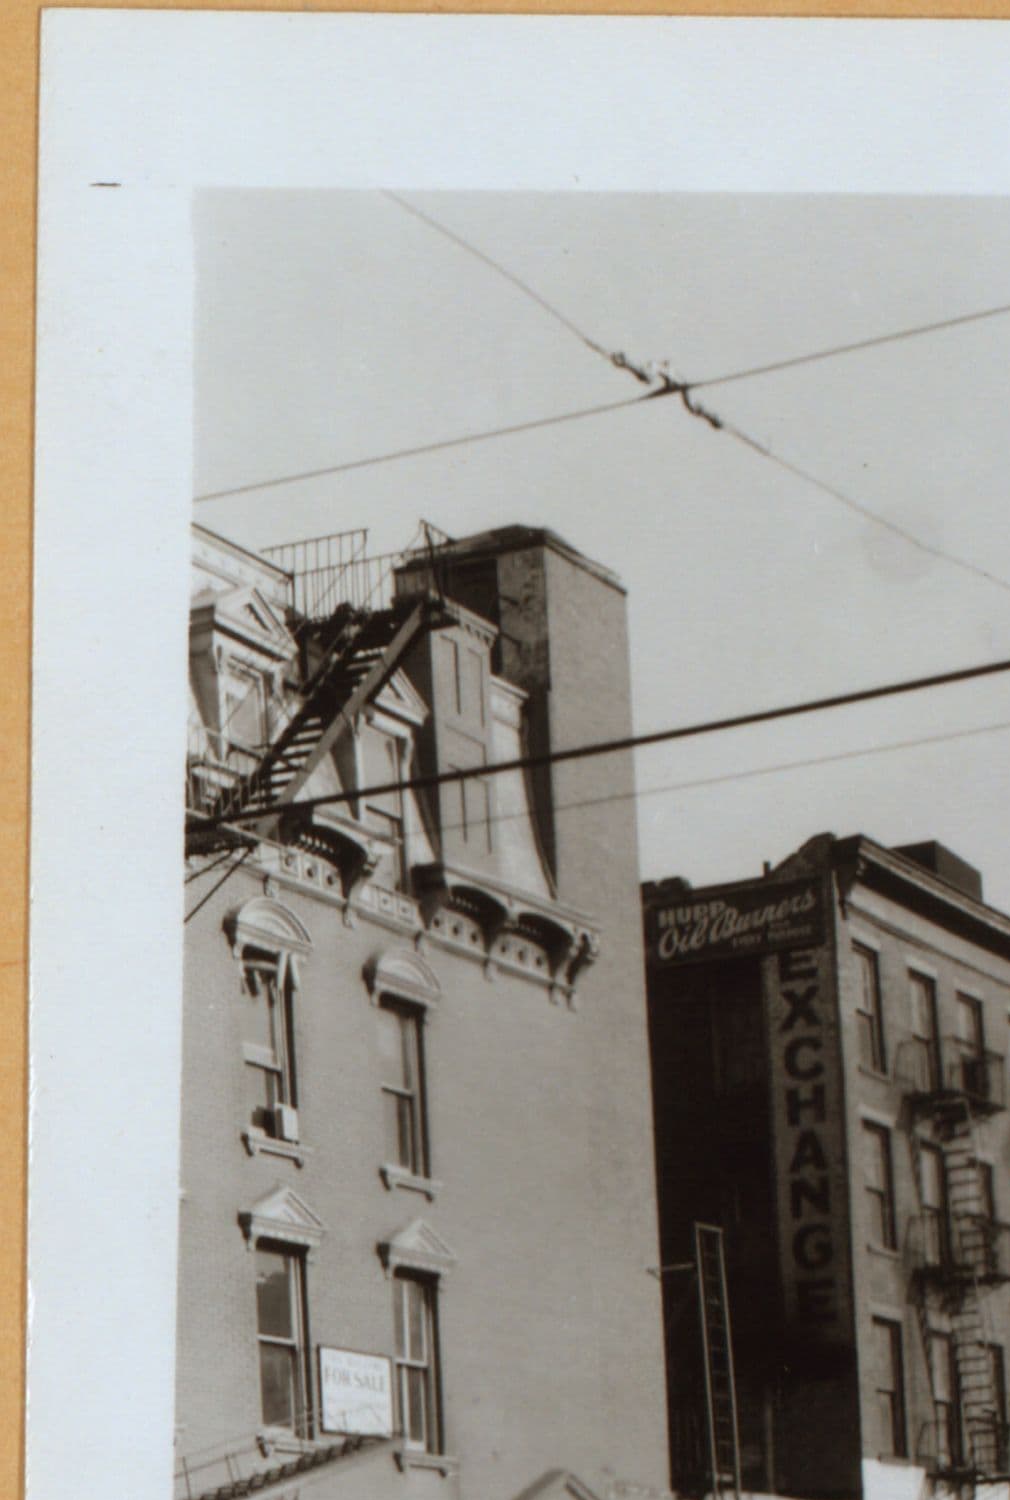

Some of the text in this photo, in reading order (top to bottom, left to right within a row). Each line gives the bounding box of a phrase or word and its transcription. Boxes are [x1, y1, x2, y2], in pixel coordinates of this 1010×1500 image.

[658, 899, 726, 929] HUPP
[658, 888, 817, 960] Oil Burners
[779, 948, 837, 1325] EXCHANGE
[325, 1365, 386, 1394] FOR SALE
